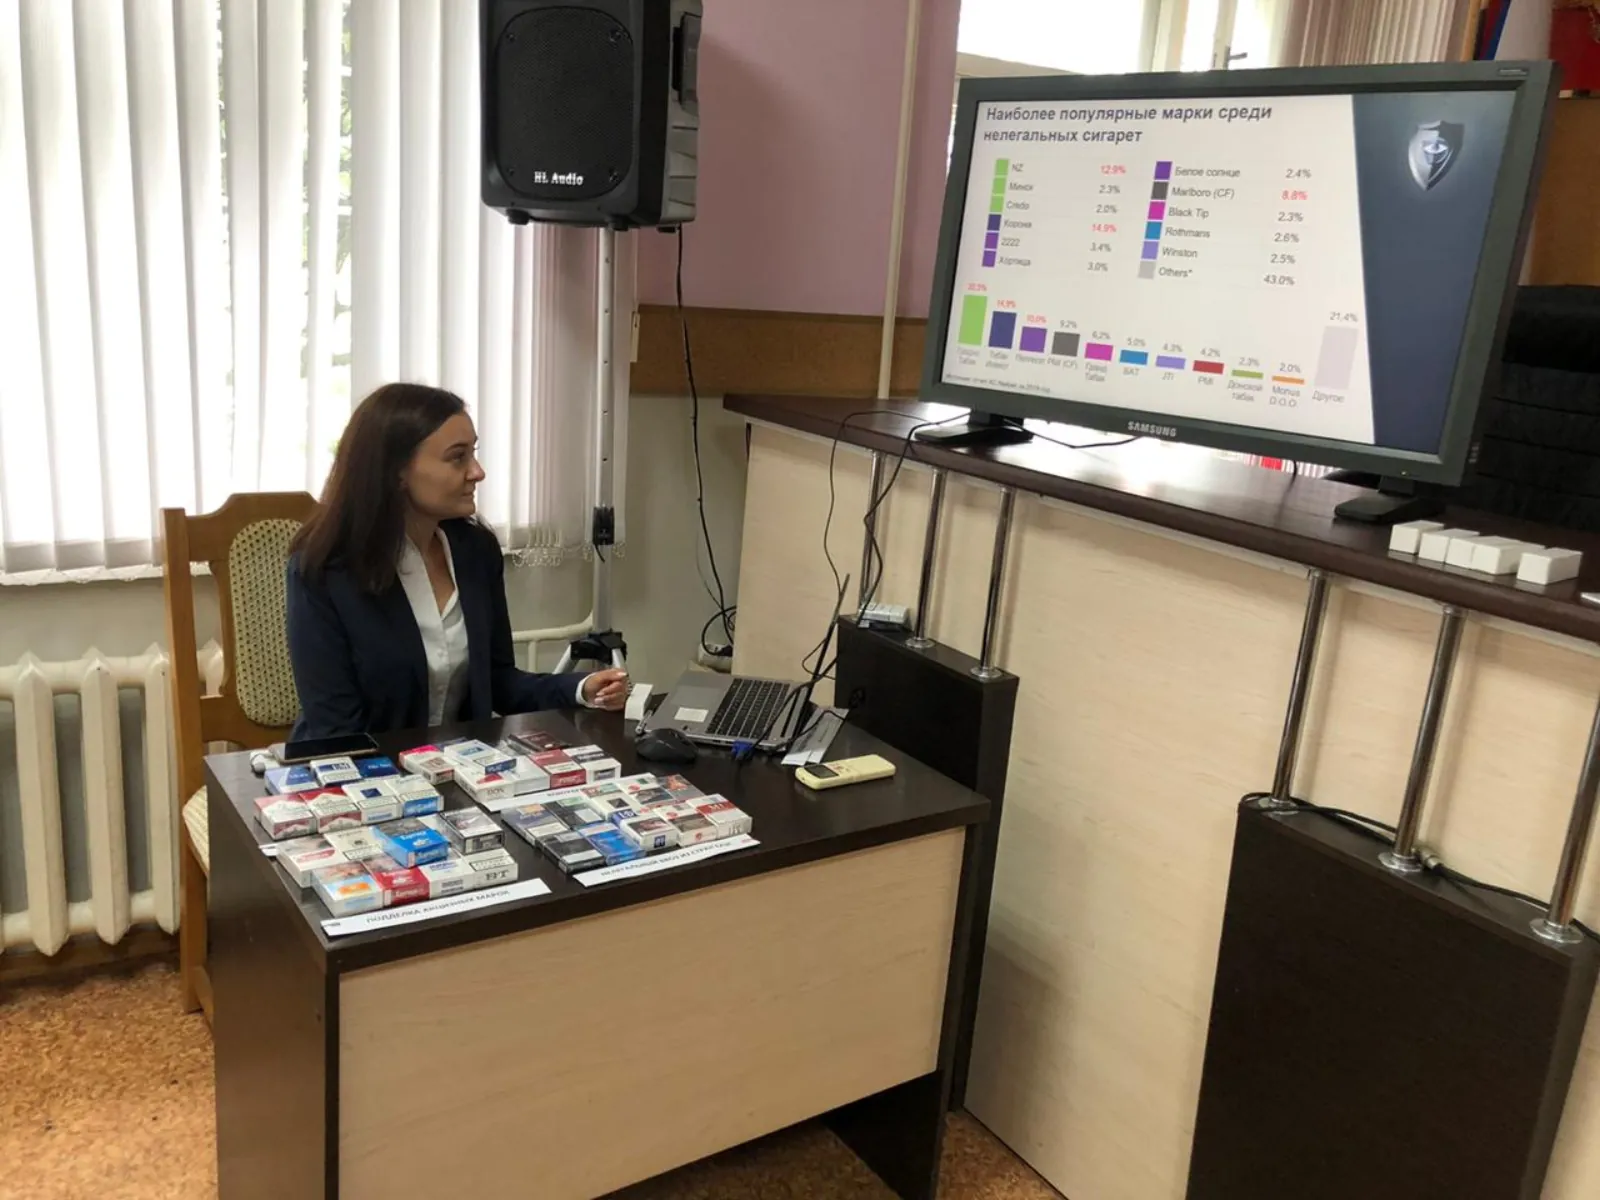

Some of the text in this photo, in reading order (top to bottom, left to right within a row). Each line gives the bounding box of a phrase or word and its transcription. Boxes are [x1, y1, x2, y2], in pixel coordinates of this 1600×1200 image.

[986, 106, 1272, 125] Наиболее популярные марки среди
[983, 130, 1143, 145] нелегальных сигарет
[550, 172, 584, 186] Audio
[1174, 167, 1311, 179] Белое солнце 2.4%
[1099, 184, 1120, 194] 2.3%
[1171, 186, 1211, 197] Marlboro
[1213, 188, 1235, 200] (CF)
[1096, 204, 1117, 213] 2.0%
[1168, 207, 1304, 222] Black Tip 2.3%
[1092, 223, 1117, 233] 14.9%
[1165, 226, 1300, 243] Rothmans 2.6%
[1162, 247, 1296, 264] Winston 2.5%
[1263, 274, 1295, 286] 43.0%
[1127, 420, 1177, 437] SAMSUNG
